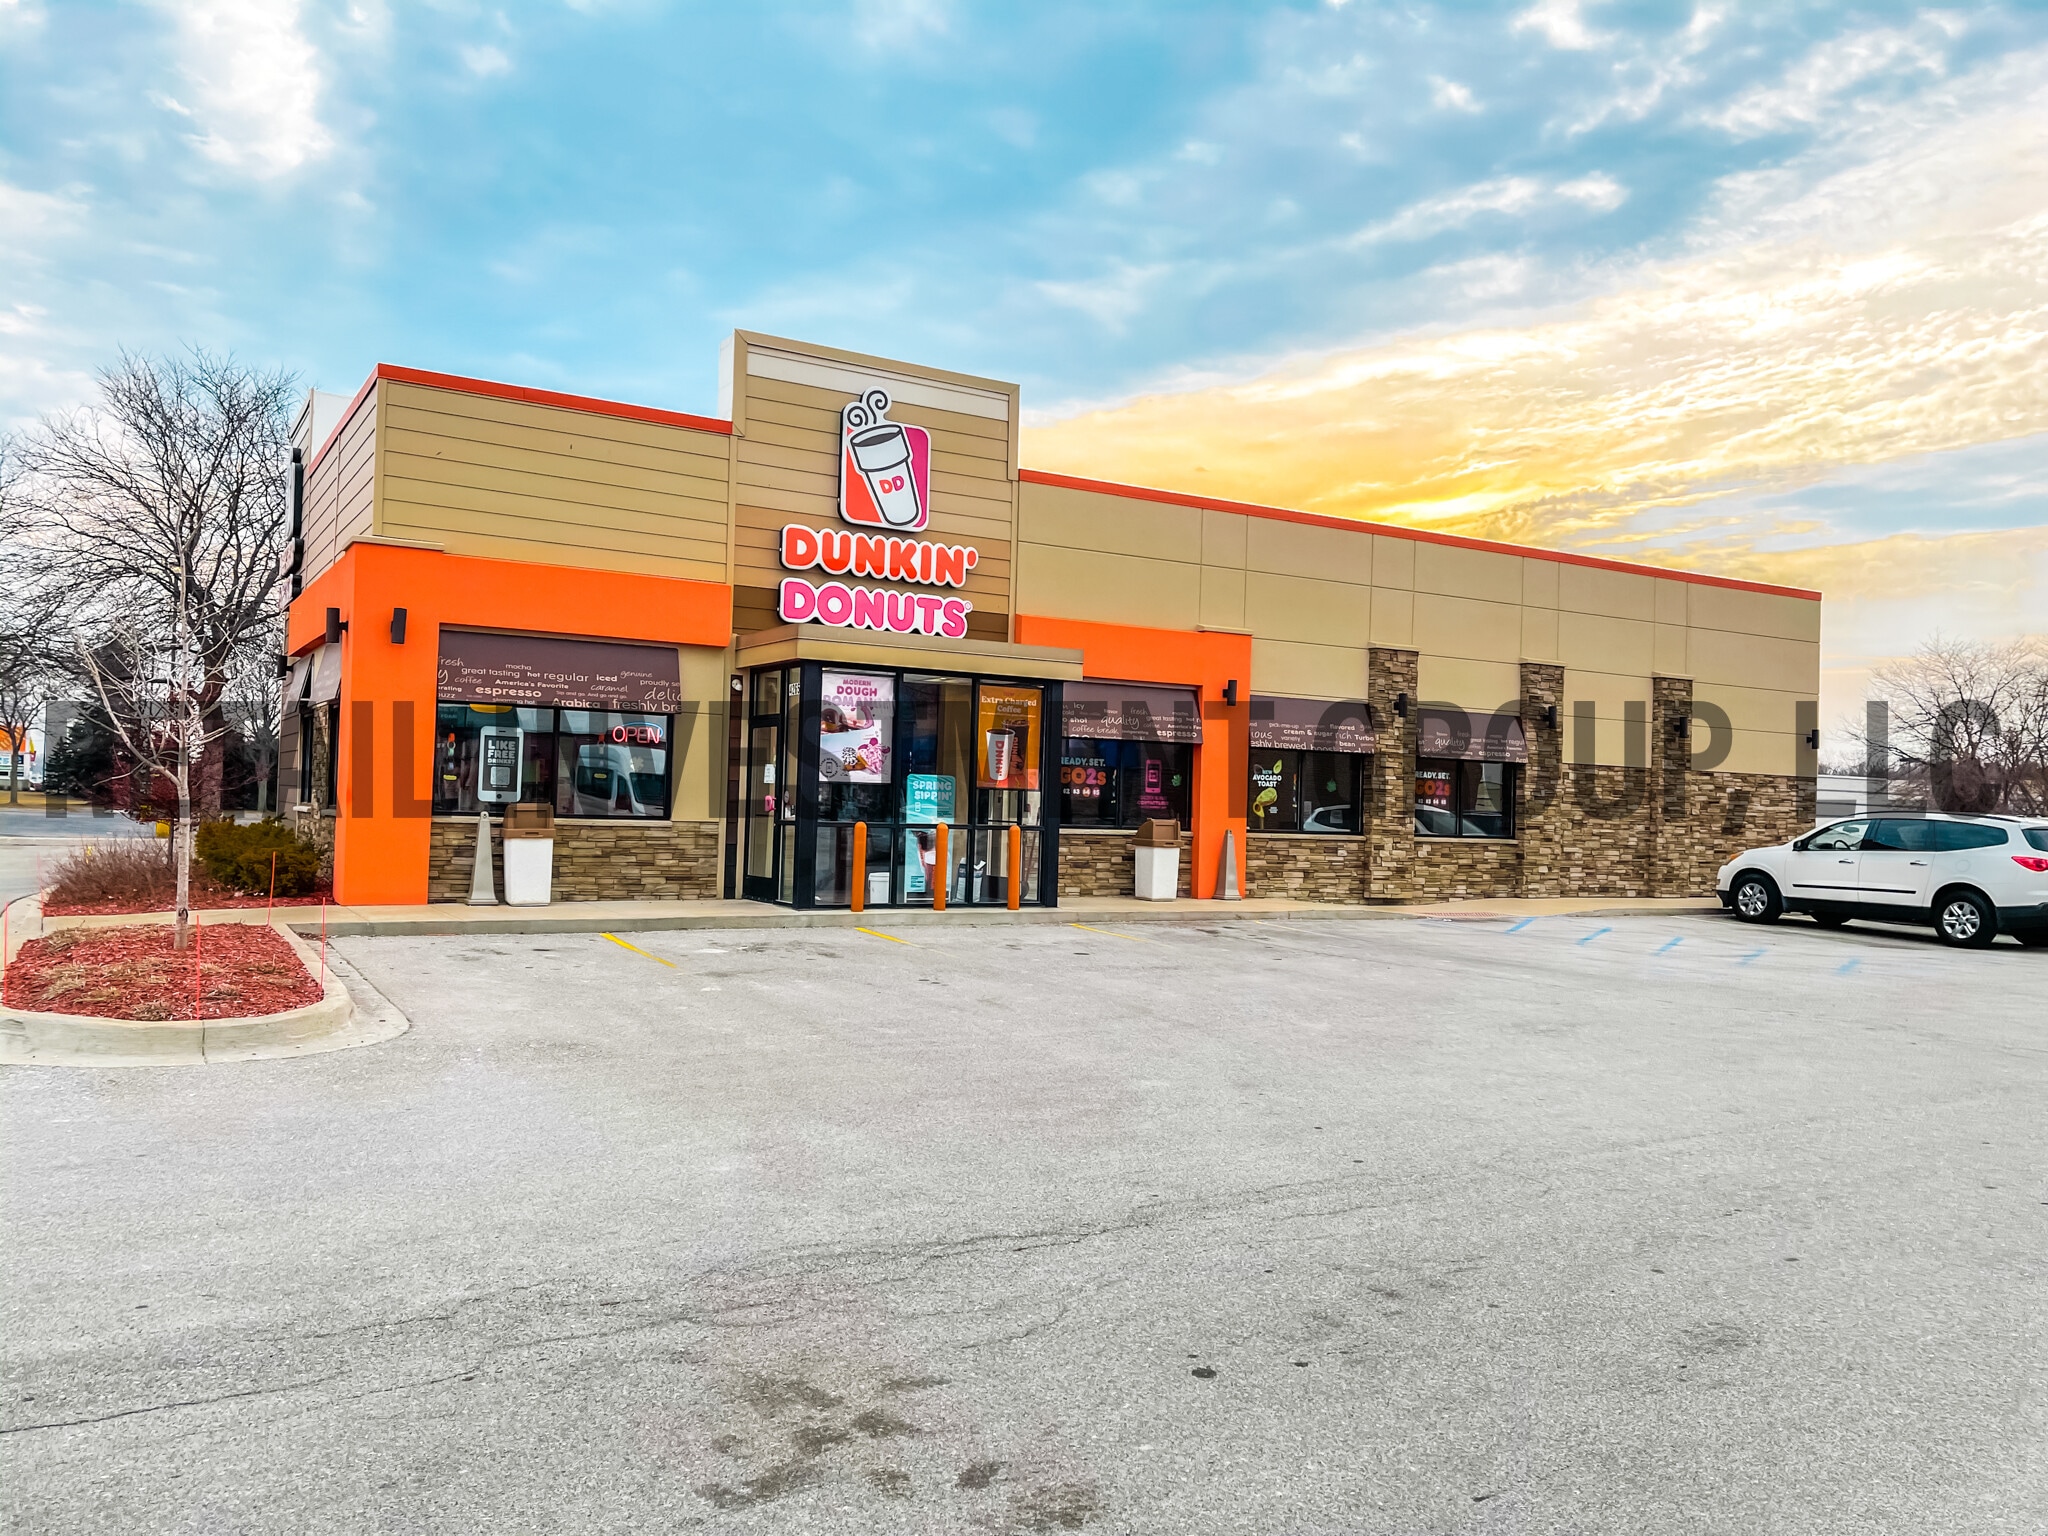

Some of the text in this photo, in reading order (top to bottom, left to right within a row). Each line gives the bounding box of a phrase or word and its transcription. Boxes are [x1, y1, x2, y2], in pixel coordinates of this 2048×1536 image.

[879, 475, 905, 494] DD
[784, 526, 978, 586] DUNKIN'
[505, 663, 532, 671] mocha
[489, 669, 520, 678] tasting
[544, 672, 589, 682] regular
[454, 676, 482, 684] coffee
[495, 679, 535, 688] America's
[843, 679, 872, 687] MODERN
[475, 686, 542, 697] espresso
[590, 684, 629, 692] caramel
[836, 685, 878, 697] DOUGH
[551, 697, 600, 709] Arabica
[613, 698, 658, 711] freshly
[981, 695, 1037, 708] Extra Charged
[997, 705, 1022, 714] Coffee
[1101, 714, 1140, 730] quality
[612, 725, 661, 744] OPEN
[1096, 726, 1120, 734] break
[1156, 730, 1197, 738] espresso
[1335, 730, 1353, 740] rich
[487, 739, 516, 751] LIKE
[1273, 740, 1307, 750] brewed
[487, 749, 516, 759] FREE
[1252, 774, 1282, 782] AVOCADO
[912, 780, 952, 791] SPRING
[914, 790, 953, 801] SIPPIN'
